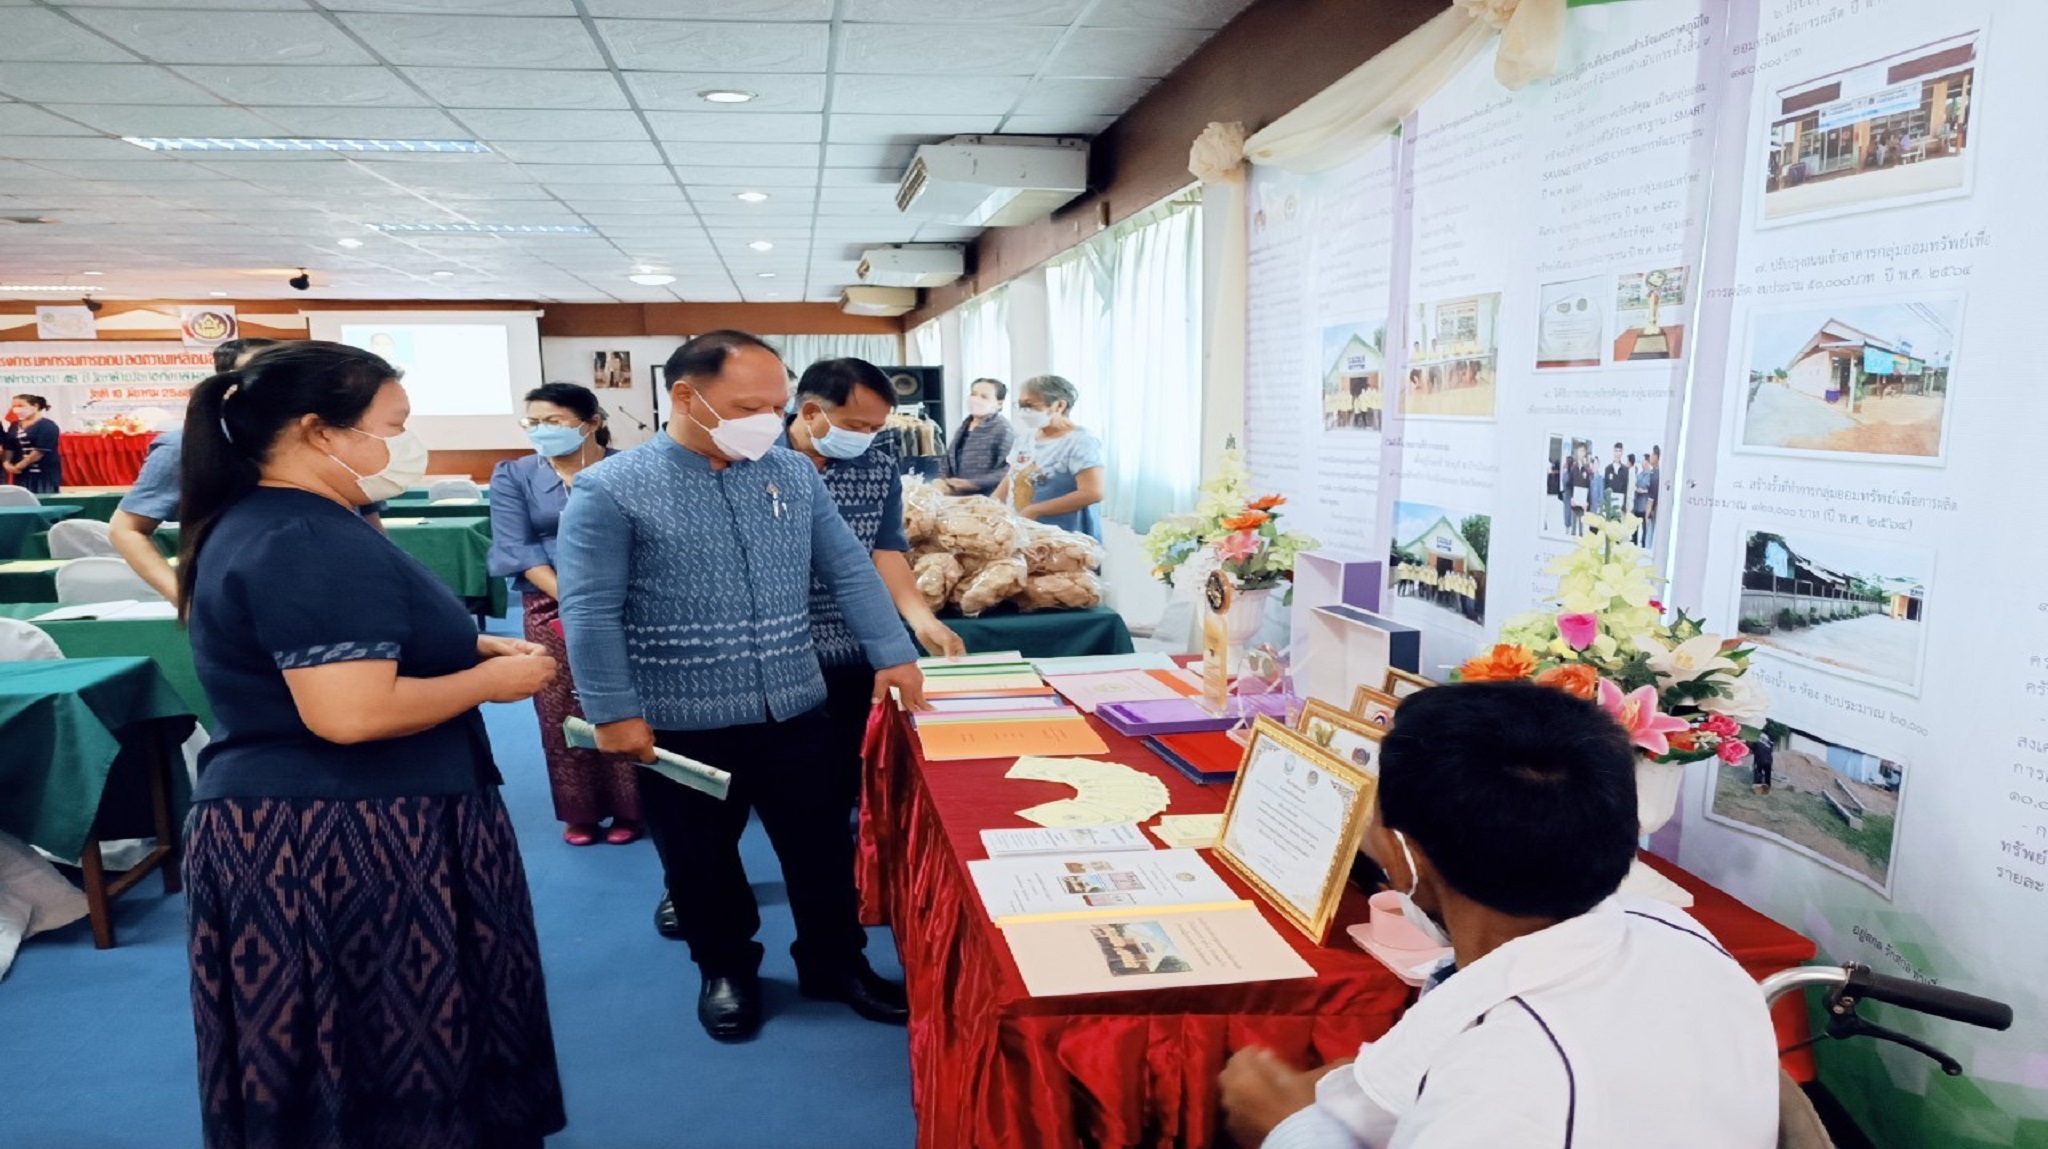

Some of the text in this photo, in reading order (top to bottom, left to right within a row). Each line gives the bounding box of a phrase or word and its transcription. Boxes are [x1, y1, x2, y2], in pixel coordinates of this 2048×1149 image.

[1885, 265, 1895, 283] ปี
[1799, 507, 1821, 521] บาท
[1839, 511, 1862, 526] พ.ศ.
[1822, 693, 1885, 719] งบประมาณ
[1996, 865, 2045, 892] รายละ
